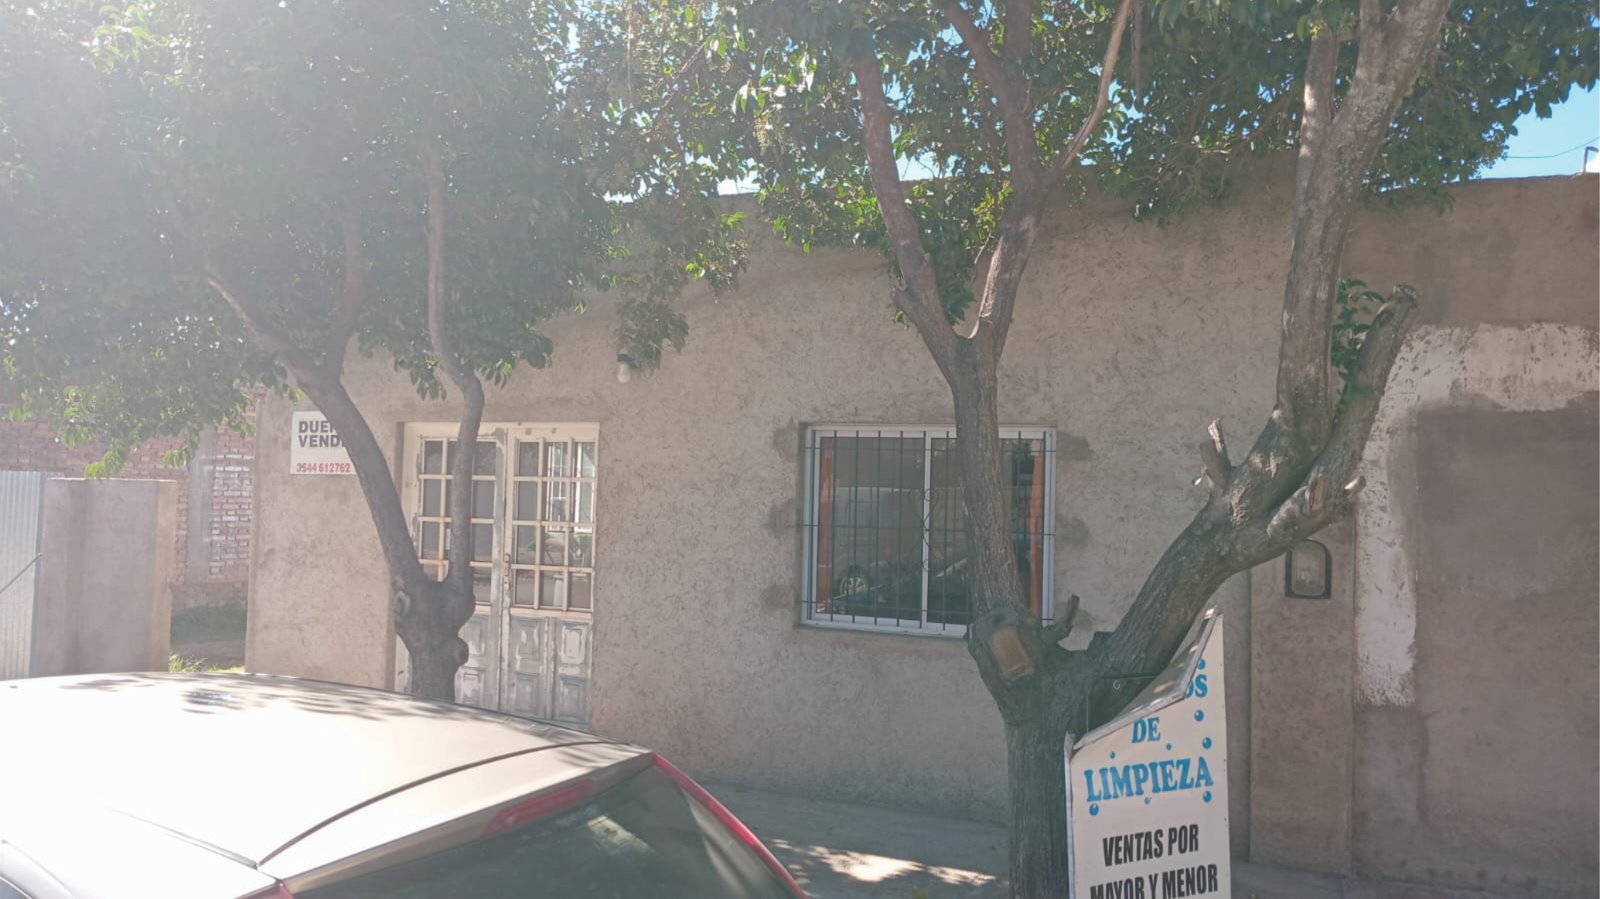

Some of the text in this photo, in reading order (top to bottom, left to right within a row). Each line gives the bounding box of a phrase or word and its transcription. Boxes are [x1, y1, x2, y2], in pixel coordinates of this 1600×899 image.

[299, 421, 333, 433] DUE
[298, 435, 345, 447] VEND
[296, 463, 351, 473] 3544 612762
[1131, 717, 1161, 744] DE
[1084, 757, 1214, 802] LIMPIEZA
[1102, 824, 1199, 867] VENTAS POR
[1148, 873, 1158, 899] Y
[1162, 864, 1218, 899] MENOR
